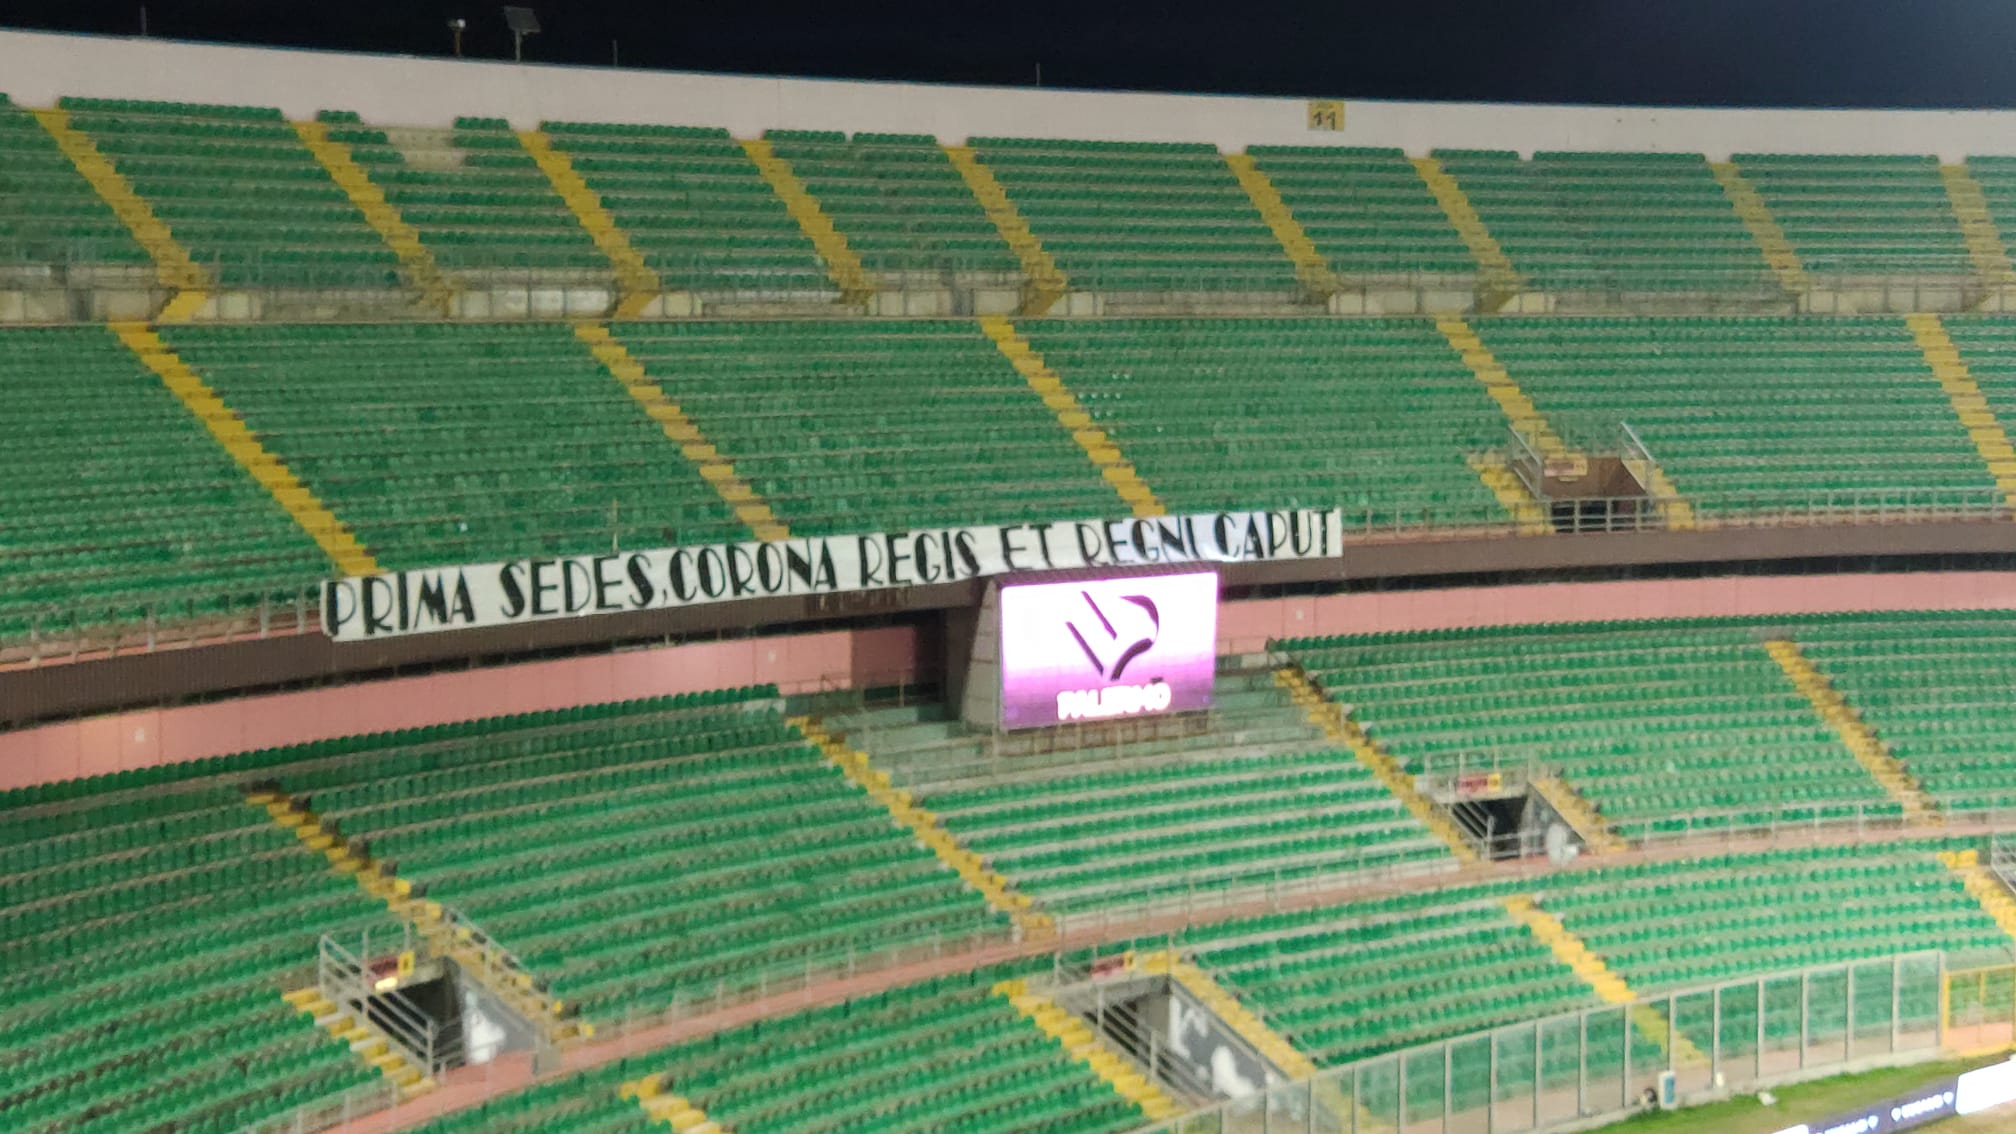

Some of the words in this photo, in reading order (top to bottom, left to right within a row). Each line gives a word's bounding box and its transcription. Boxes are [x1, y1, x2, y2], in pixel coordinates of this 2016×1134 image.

[1312, 111, 1336, 131] 11
[326, 567, 476, 636] PRIMA
[858, 530, 981, 587] REGIS
[1000, 523, 1054, 572] ET
[1075, 512, 1201, 568] REGNI
[1214, 508, 1335, 559] CAPUT
